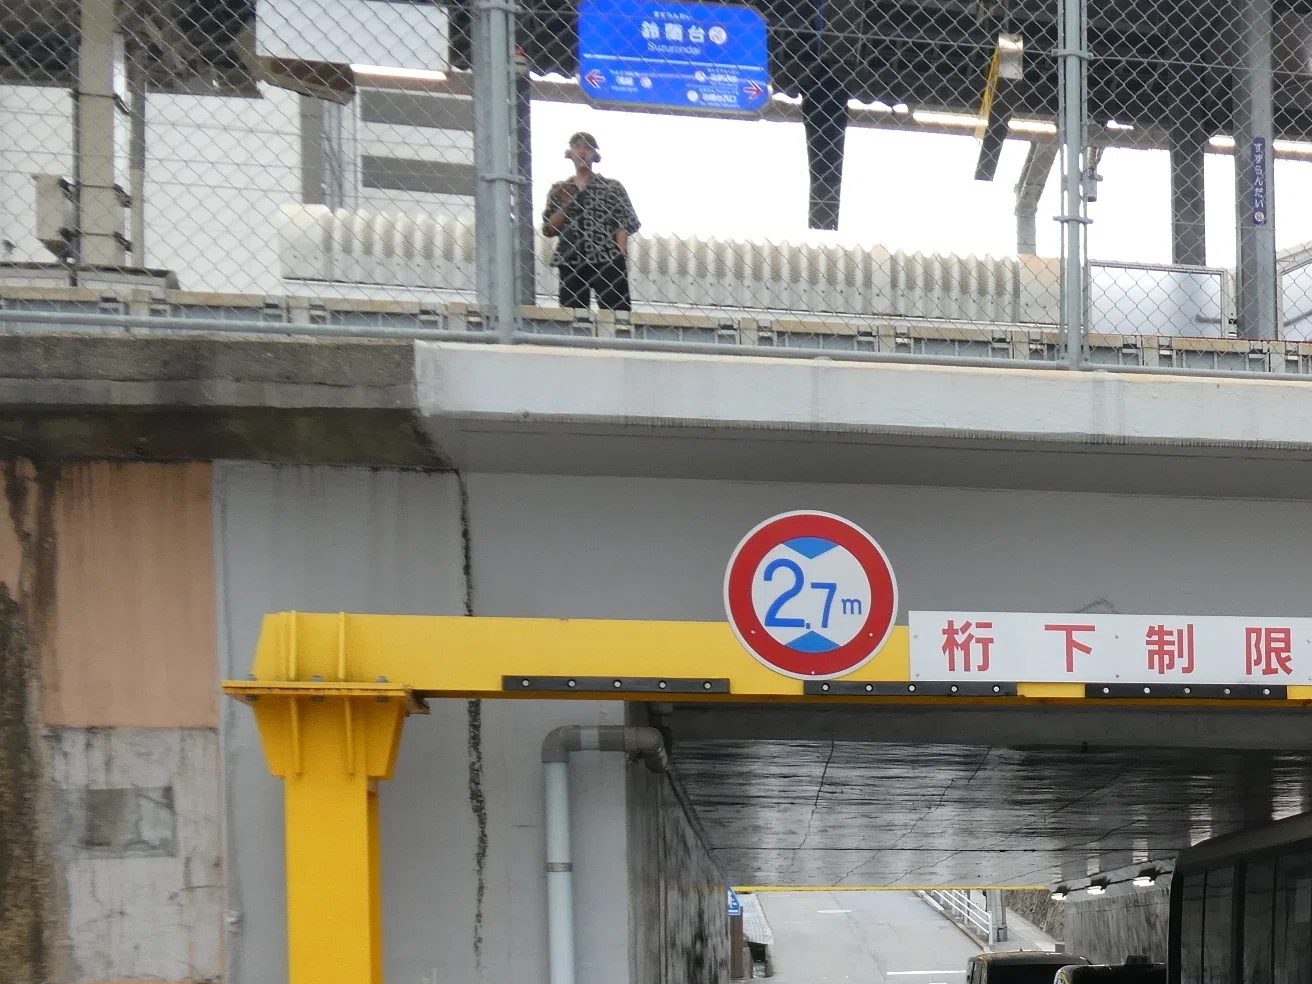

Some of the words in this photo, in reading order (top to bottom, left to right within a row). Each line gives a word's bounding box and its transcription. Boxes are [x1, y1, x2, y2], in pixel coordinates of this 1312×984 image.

[641, 20, 706, 44] 鈴蘭台
[1254, 142, 1264, 208] すずらんだい
[763, 558, 862, 630] 2.7m
